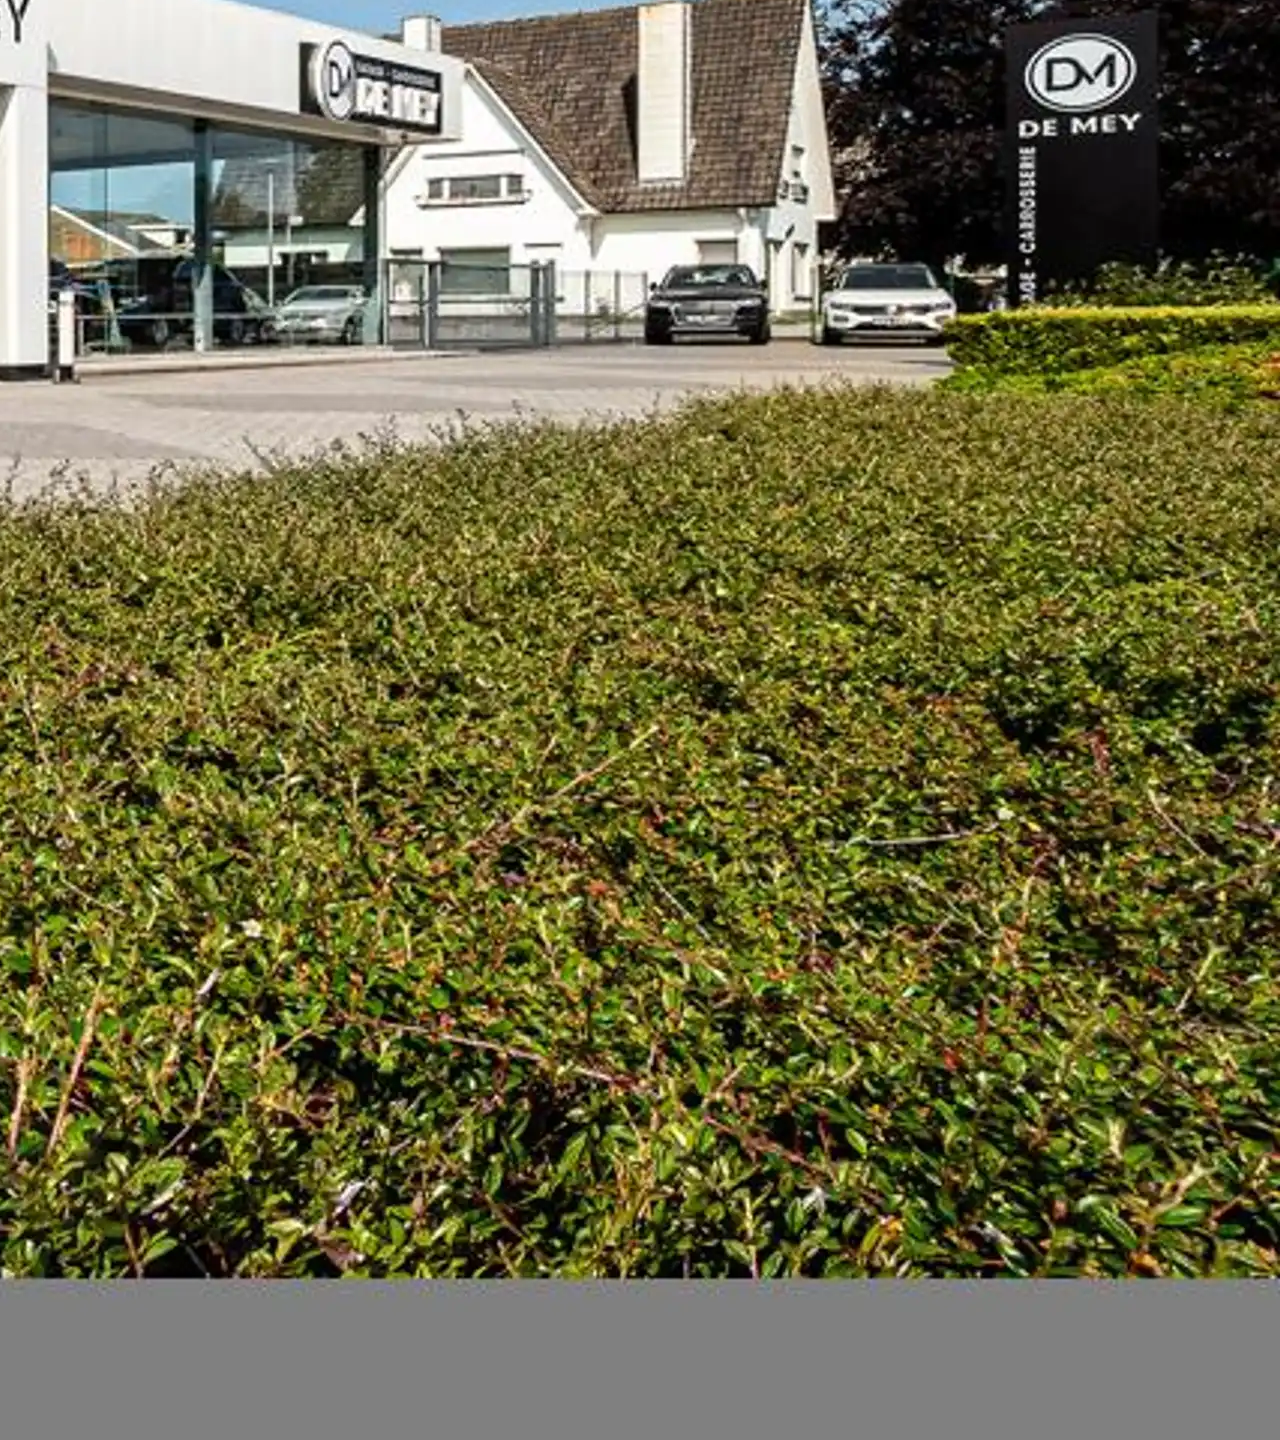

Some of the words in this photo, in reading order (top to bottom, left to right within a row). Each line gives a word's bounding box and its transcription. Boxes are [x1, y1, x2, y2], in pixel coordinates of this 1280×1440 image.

[1018, 119, 1058, 138] DE
[1069, 112, 1141, 136] MEY
[1018, 145, 1037, 253] CARROSSERIE
